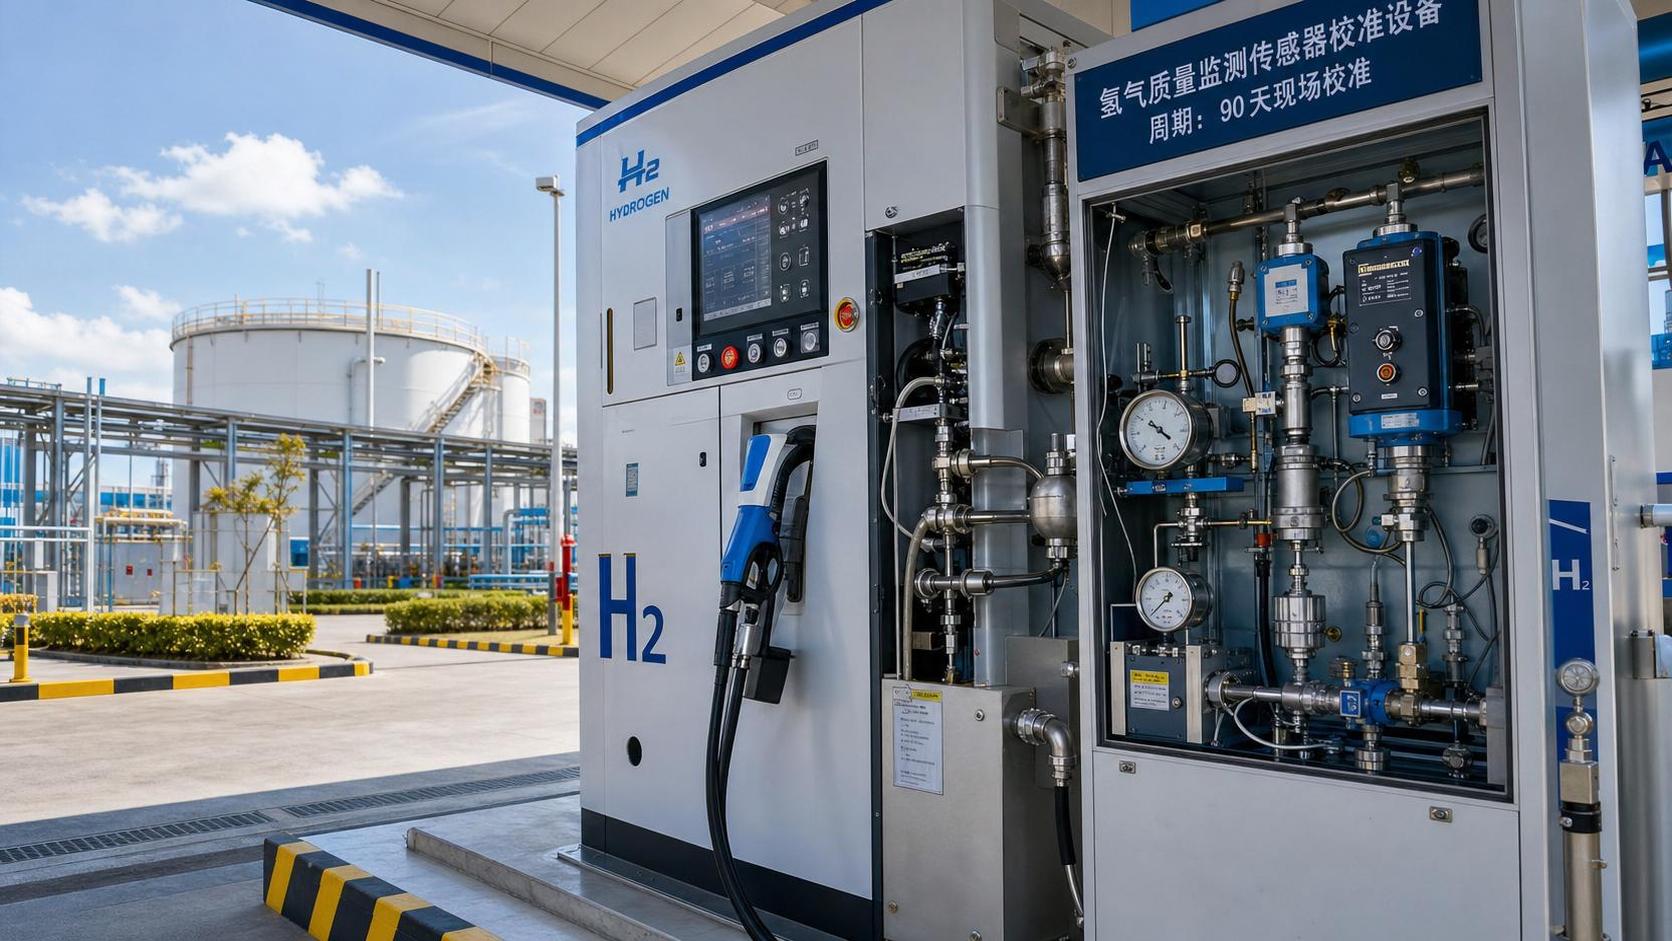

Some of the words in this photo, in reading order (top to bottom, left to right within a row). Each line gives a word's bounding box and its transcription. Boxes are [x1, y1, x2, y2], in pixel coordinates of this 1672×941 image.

[1099, 0, 1442, 119] 氢气质量监测传感器校准设备
[609, 187, 669, 222] HYDROGEN
